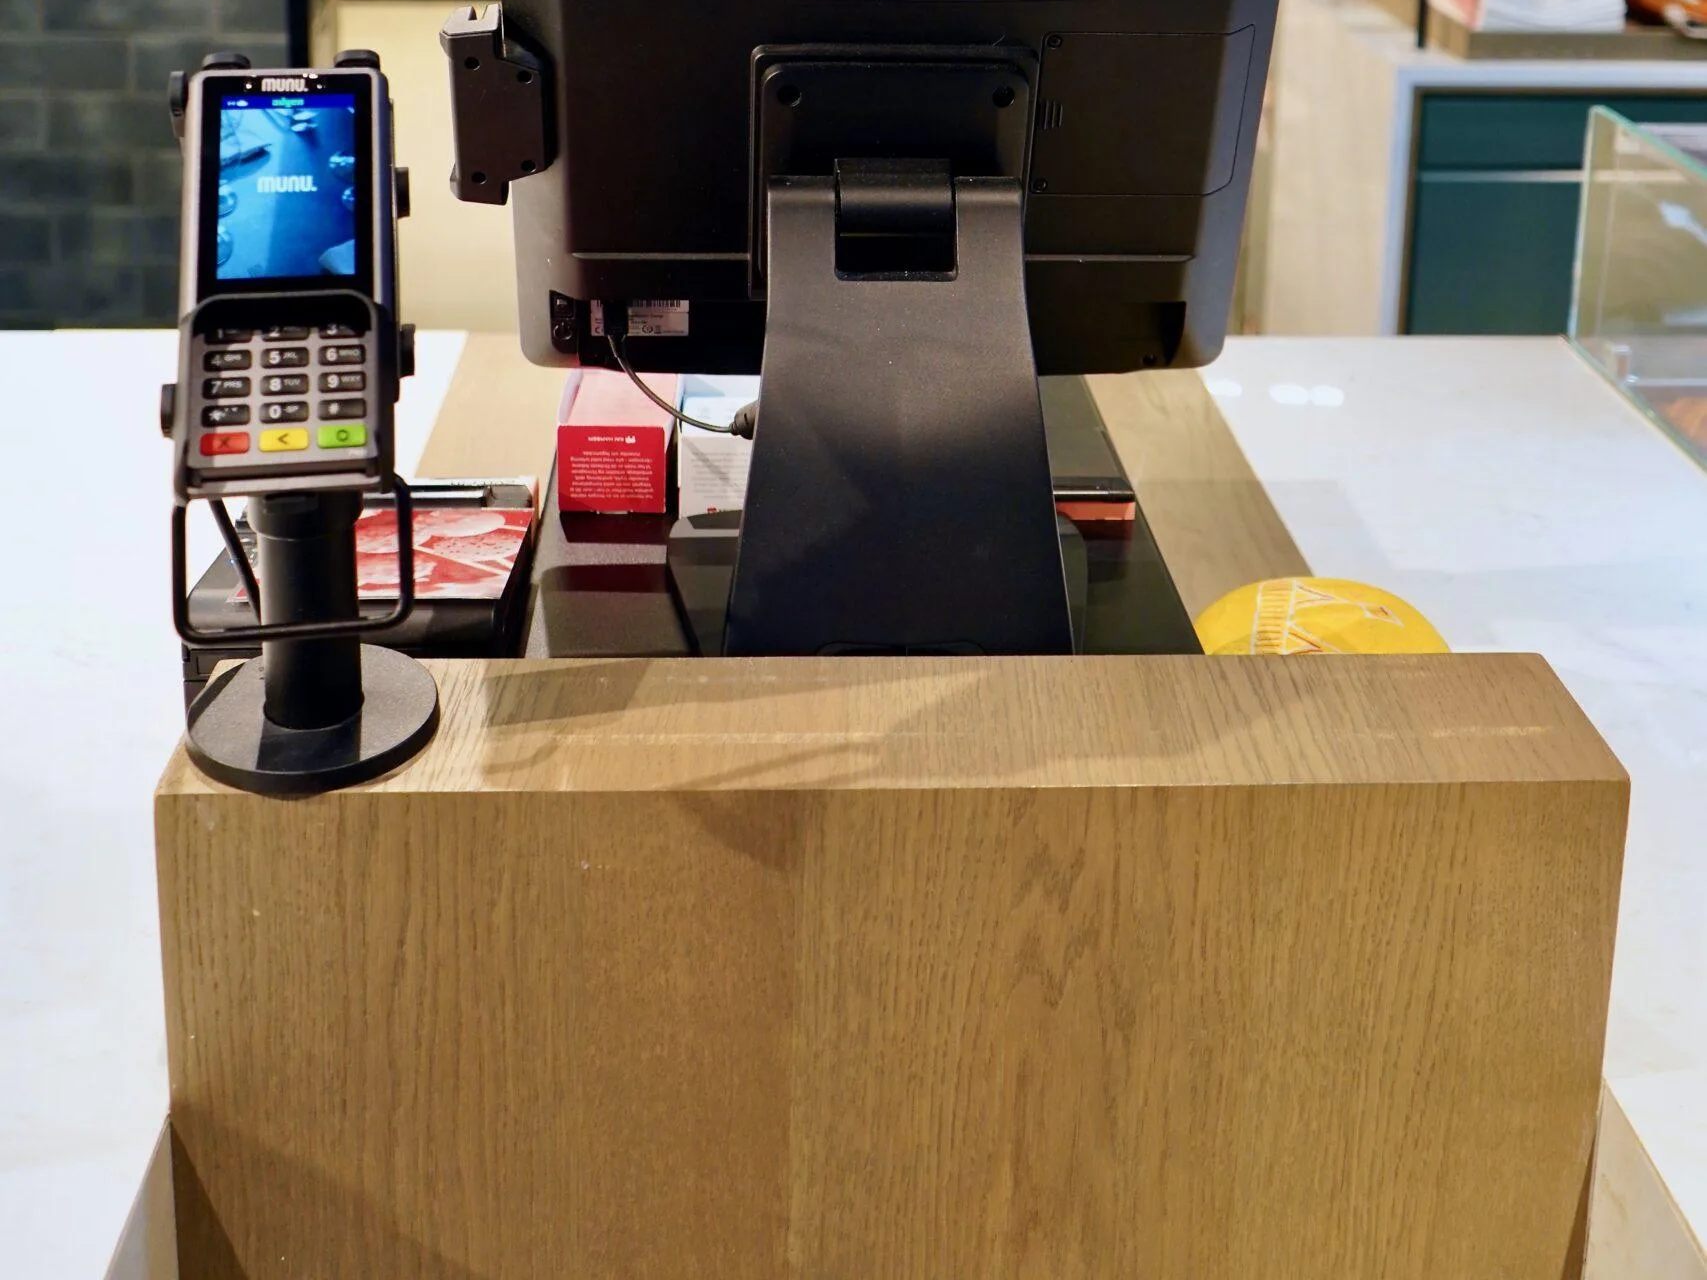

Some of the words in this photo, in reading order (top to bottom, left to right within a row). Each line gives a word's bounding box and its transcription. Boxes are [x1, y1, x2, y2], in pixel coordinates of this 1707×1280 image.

[269, 351, 281, 364] 5
[326, 347, 338, 361] 6
[211, 380, 222, 394] 7
[269, 377, 282, 391] 8
[327, 374, 339, 388] 9
[269, 405, 281, 419] 0
